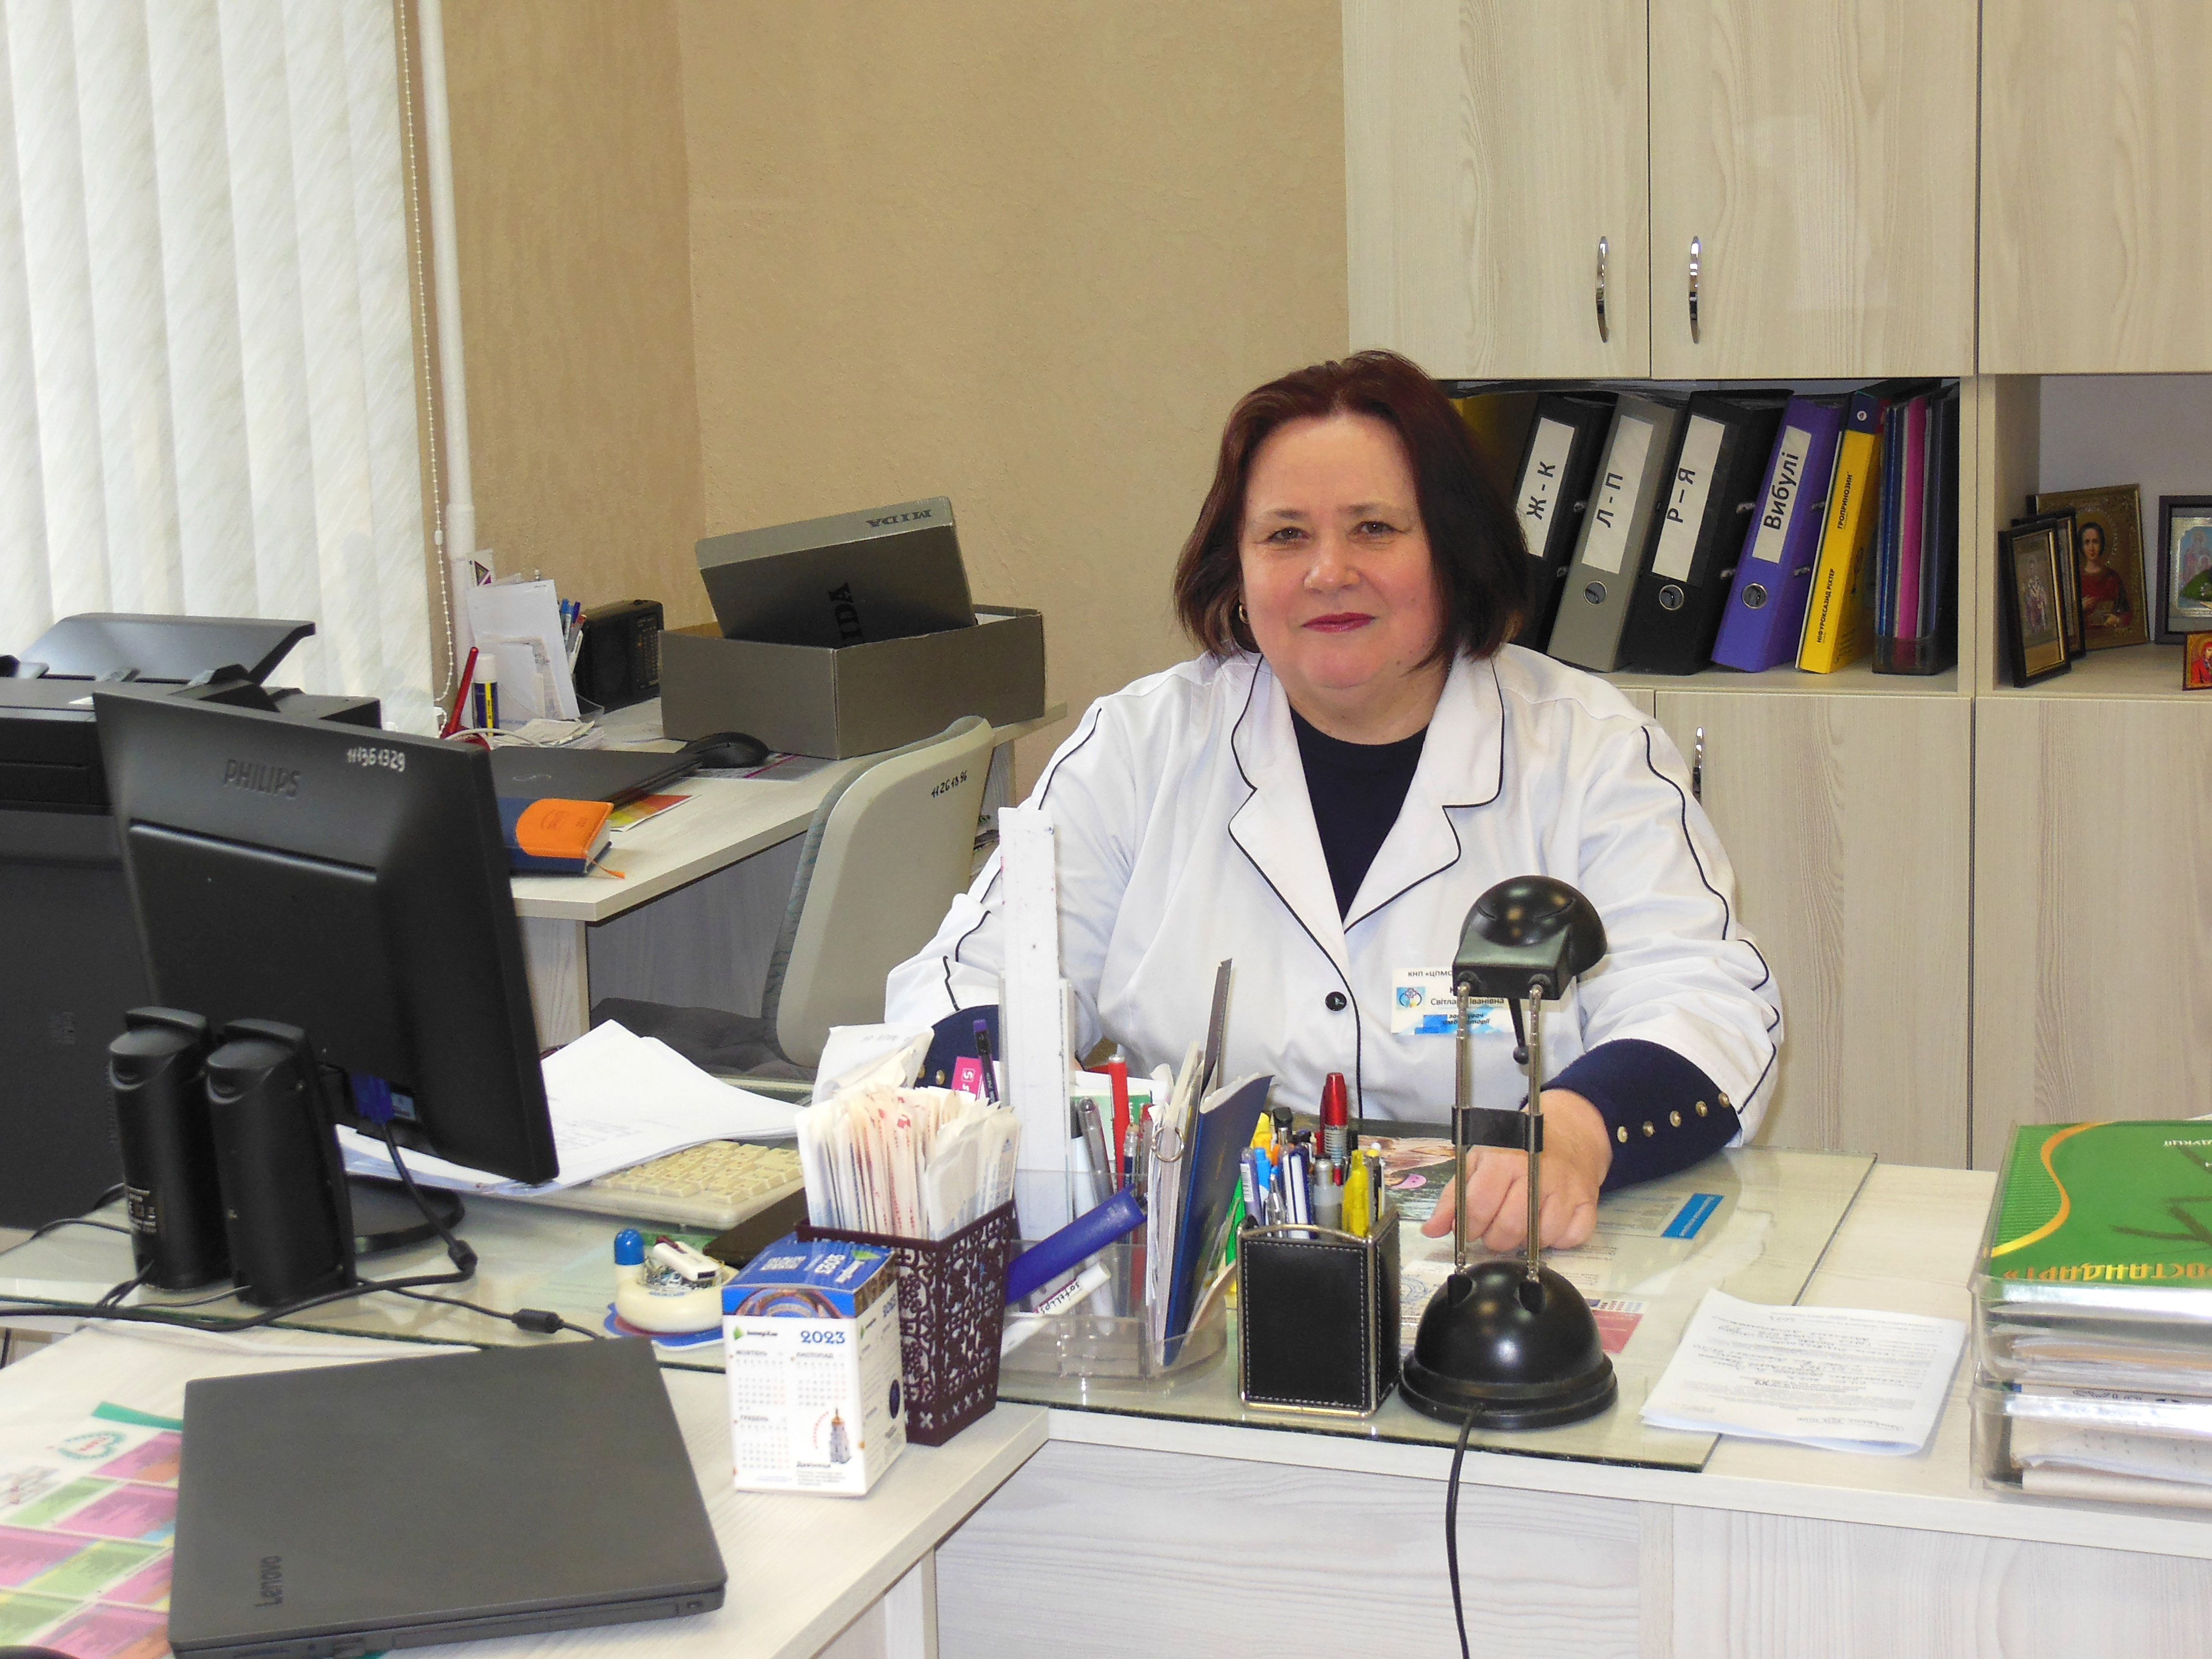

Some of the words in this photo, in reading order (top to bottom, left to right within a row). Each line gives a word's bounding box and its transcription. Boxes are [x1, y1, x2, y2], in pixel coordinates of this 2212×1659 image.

[1763, 451, 1799, 530] Вибулі
[866, 509, 932, 528] MIDA
[1827, 568, 1836, 589] РІХТЕР
[828, 582, 863, 641] IDA
[224, 758, 301, 798] PHILIPS
[1431, 998, 1459, 1006] Світла
[2003, 1262, 2212, 1282] ОСТАНДАРТ»
[801, 1330, 845, 1344] 2023
